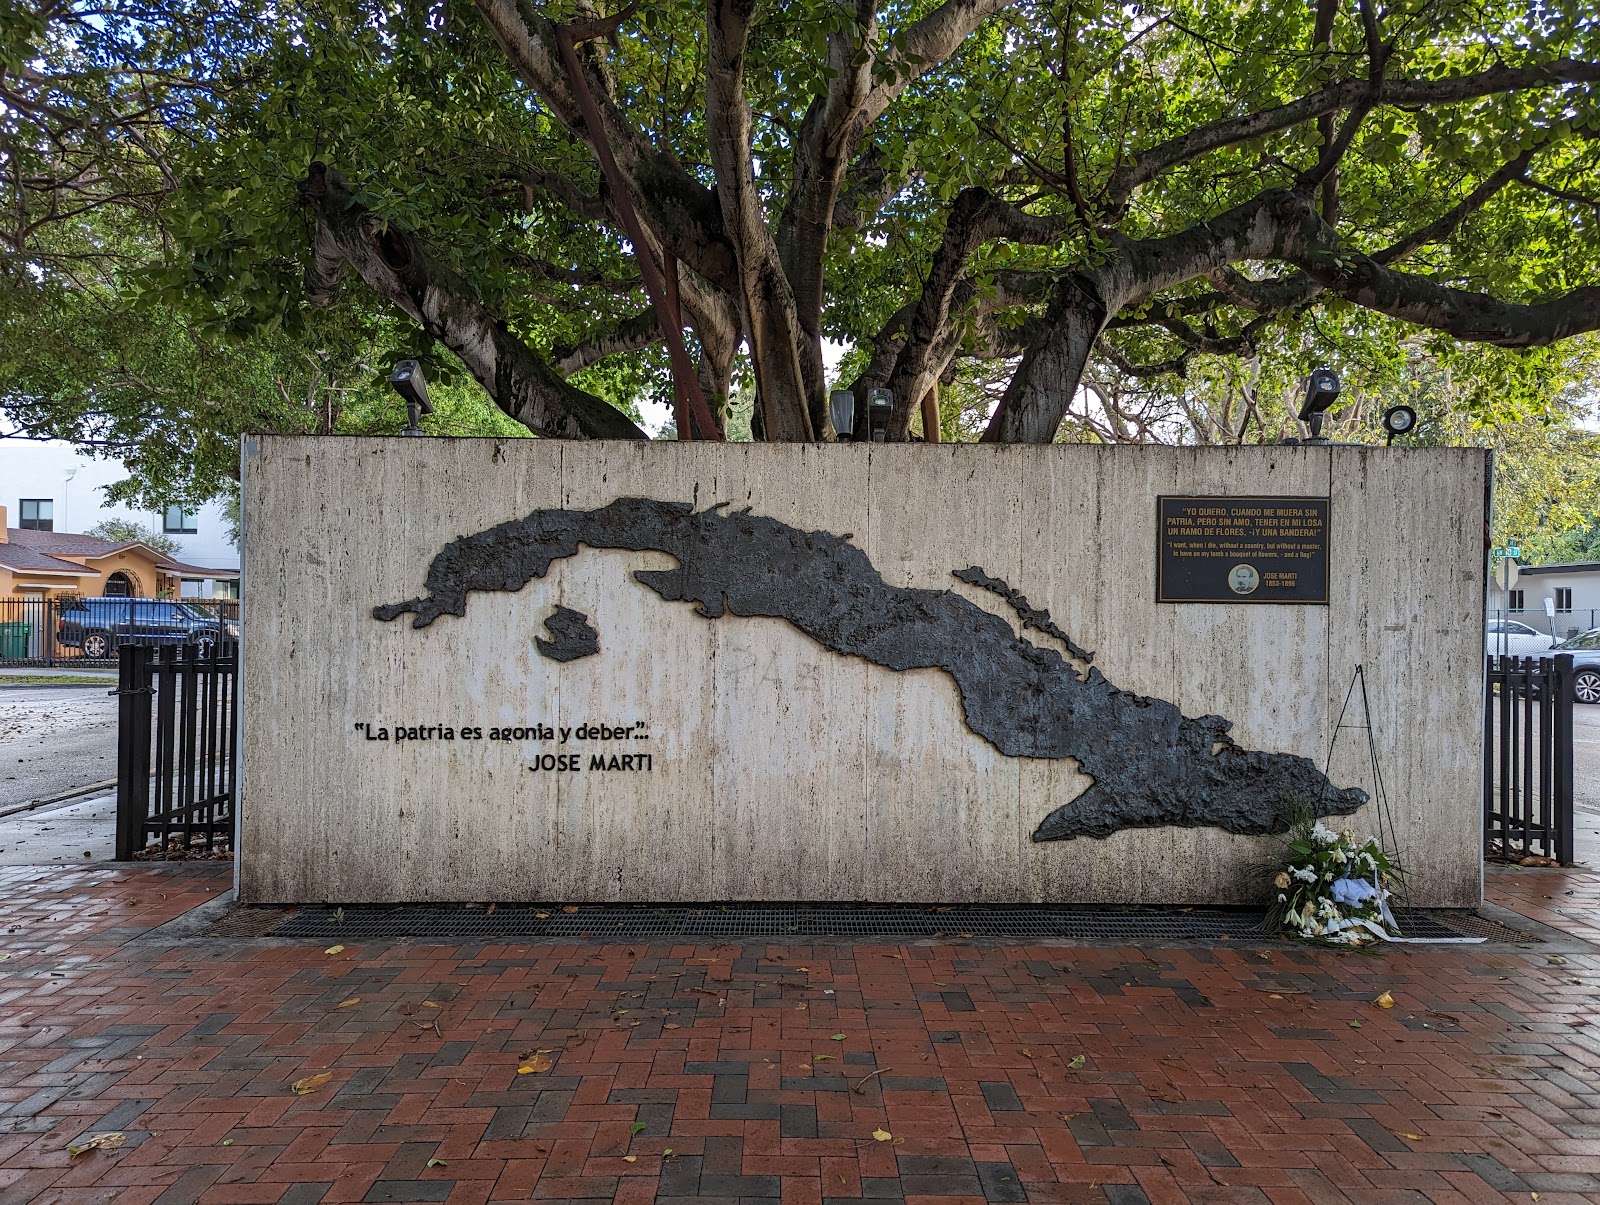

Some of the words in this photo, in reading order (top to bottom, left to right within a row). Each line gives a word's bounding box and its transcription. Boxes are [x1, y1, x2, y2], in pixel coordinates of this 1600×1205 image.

[1182, 508, 1196, 516] "YO
[1199, 508, 1229, 517] QUIERO,
[1231, 508, 1261, 516] CUANDO
[1264, 508, 1275, 516] ME
[1277, 508, 1303, 517] MUERA
[1305, 509, 1317, 517] SIN
[1167, 518, 1195, 526] PATRIA,
[1198, 518, 1217, 526] PERO
[1219, 518, 1231, 526] SIN
[1234, 518, 1252, 527] AMO,
[1255, 518, 1278, 526] TENER
[1292, 519, 1300, 527] MI
[1303, 519, 1322, 527] LOSA
[1181, 528, 1202, 536] RAMO
[1204, 528, 1214, 536] DE
[1216, 528, 1246, 537] FLORES,
[355, 722, 389, 741] "La
[395, 723, 455, 744] patria
[460, 727, 482, 741] es
[489, 723, 554, 742] agonia
[559, 727, 572, 744] y
[528, 754, 581, 771] JOSE
[589, 754, 652, 771] MARTI
